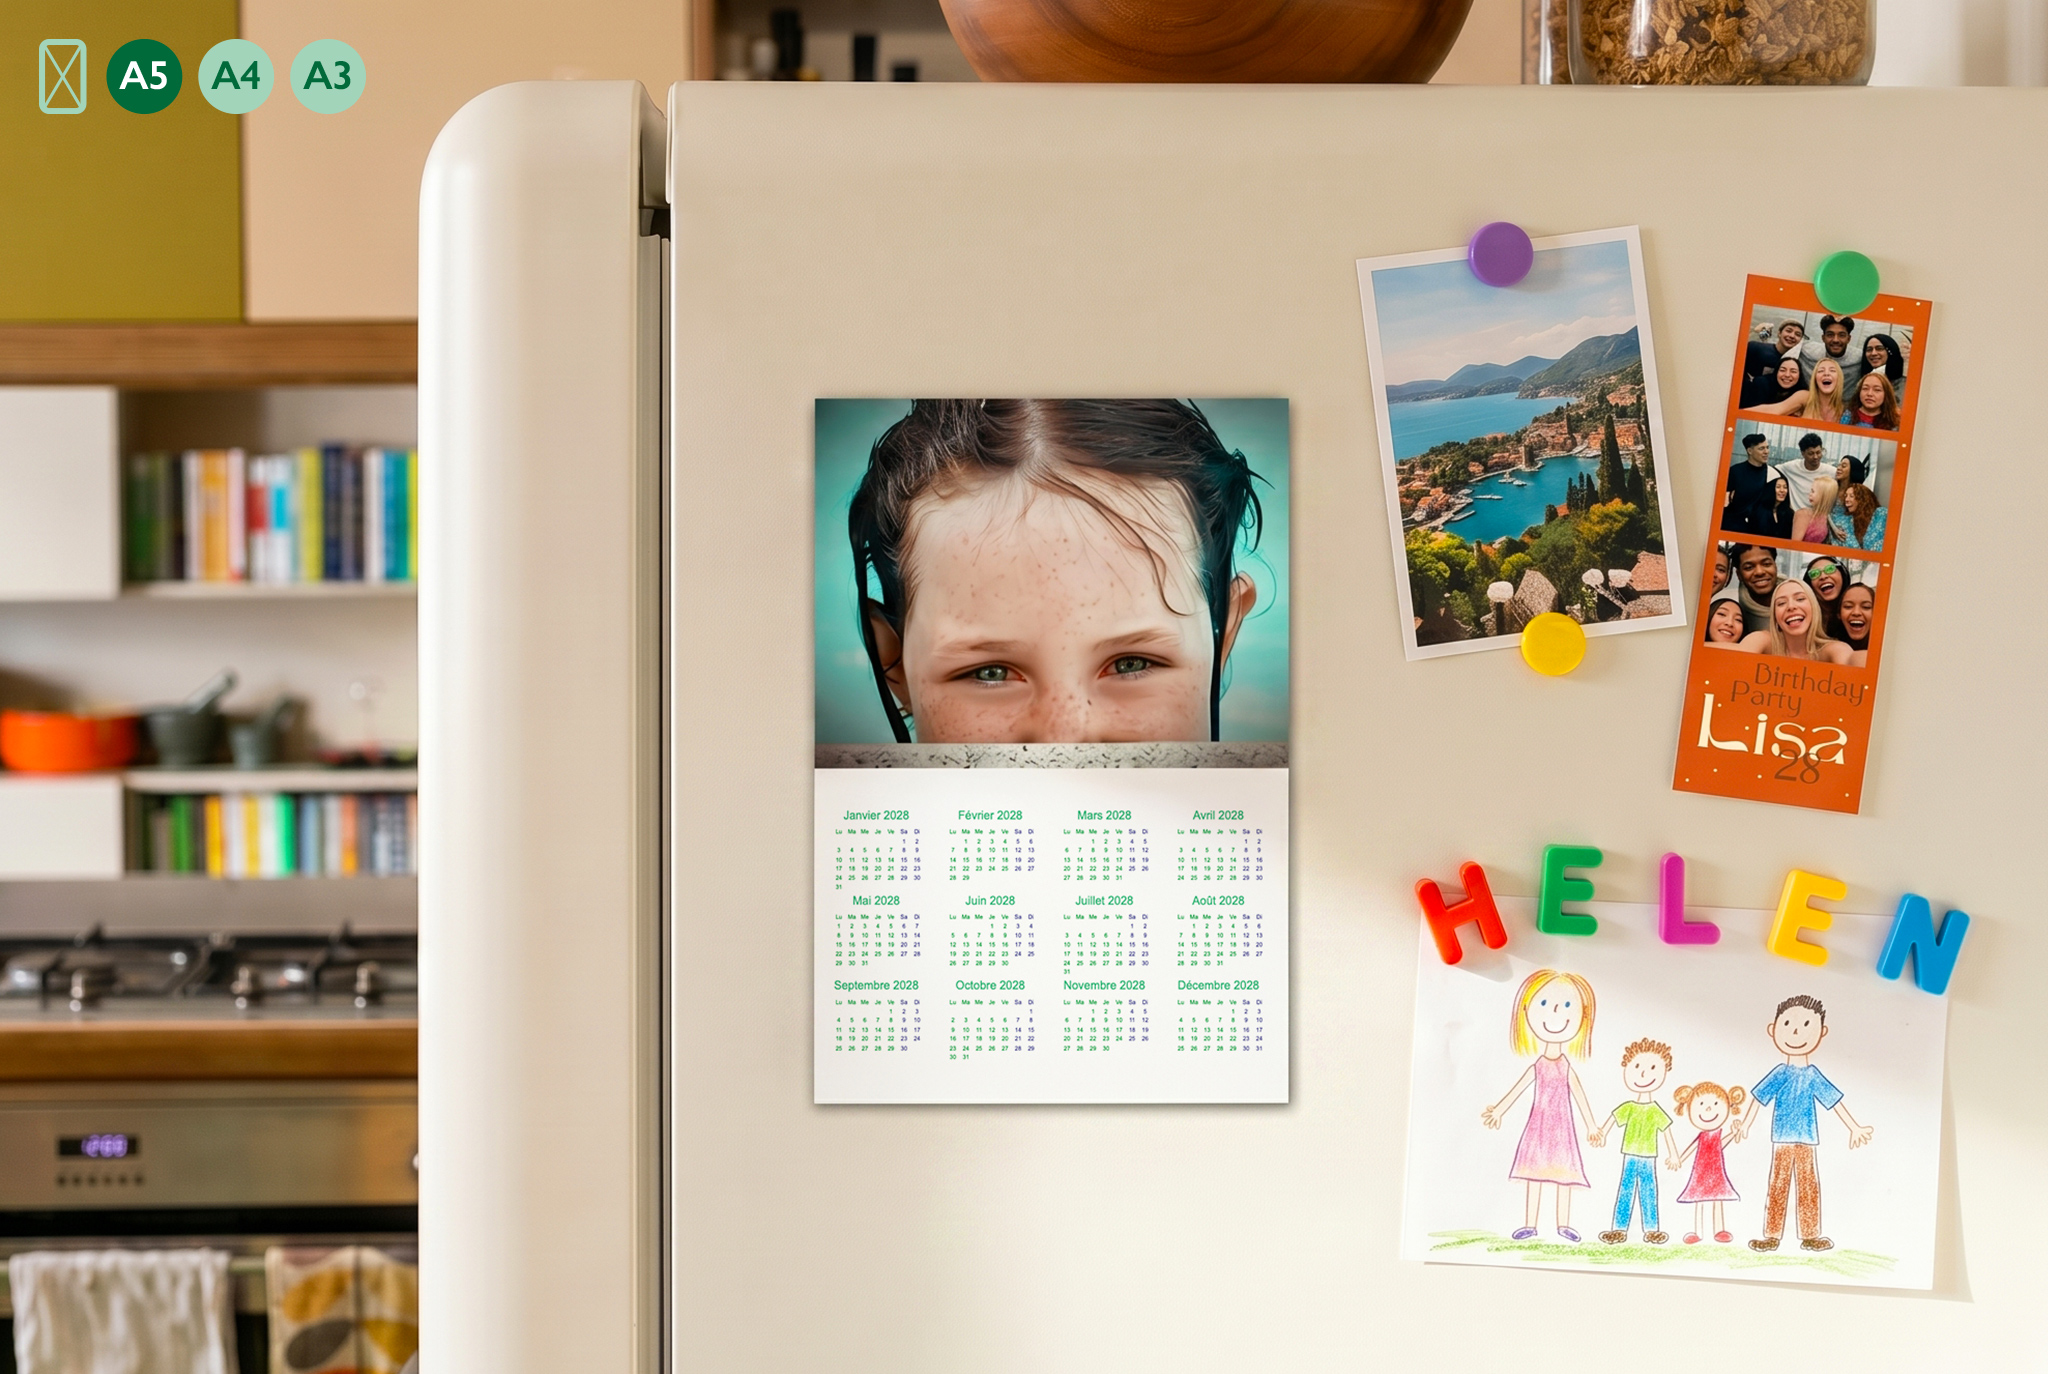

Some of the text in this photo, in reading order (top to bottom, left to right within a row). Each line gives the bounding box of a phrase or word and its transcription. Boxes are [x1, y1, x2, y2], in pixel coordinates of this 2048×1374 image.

[1755, 662, 1865, 707] Birthday
[1731, 680, 1802, 718] Party
[1698, 693, 1848, 765] Lisa
[1774, 749, 1821, 785] 28
[844, 810, 910, 820] Janvier 2028
[958, 810, 1022, 820] Février 2028
[1078, 810, 1132, 820] Mars 2028
[1192, 810, 1244, 820] Avril 2028
[852, 896, 900, 906] Mai 2028
[964, 896, 1016, 906] Juin 2028
[1074, 896, 1134, 906] Juillet 2028
[1192, 896, 1244, 906] Août 2028
[1414, 843, 1971, 995] HELEN
[834, 980, 920, 992] Septembre 2028
[956, 980, 1026, 990] Octobre 2028
[1064, 980, 1146, 990] Novembre 2028
[1178, 980, 1260, 990] Décembre 2028
